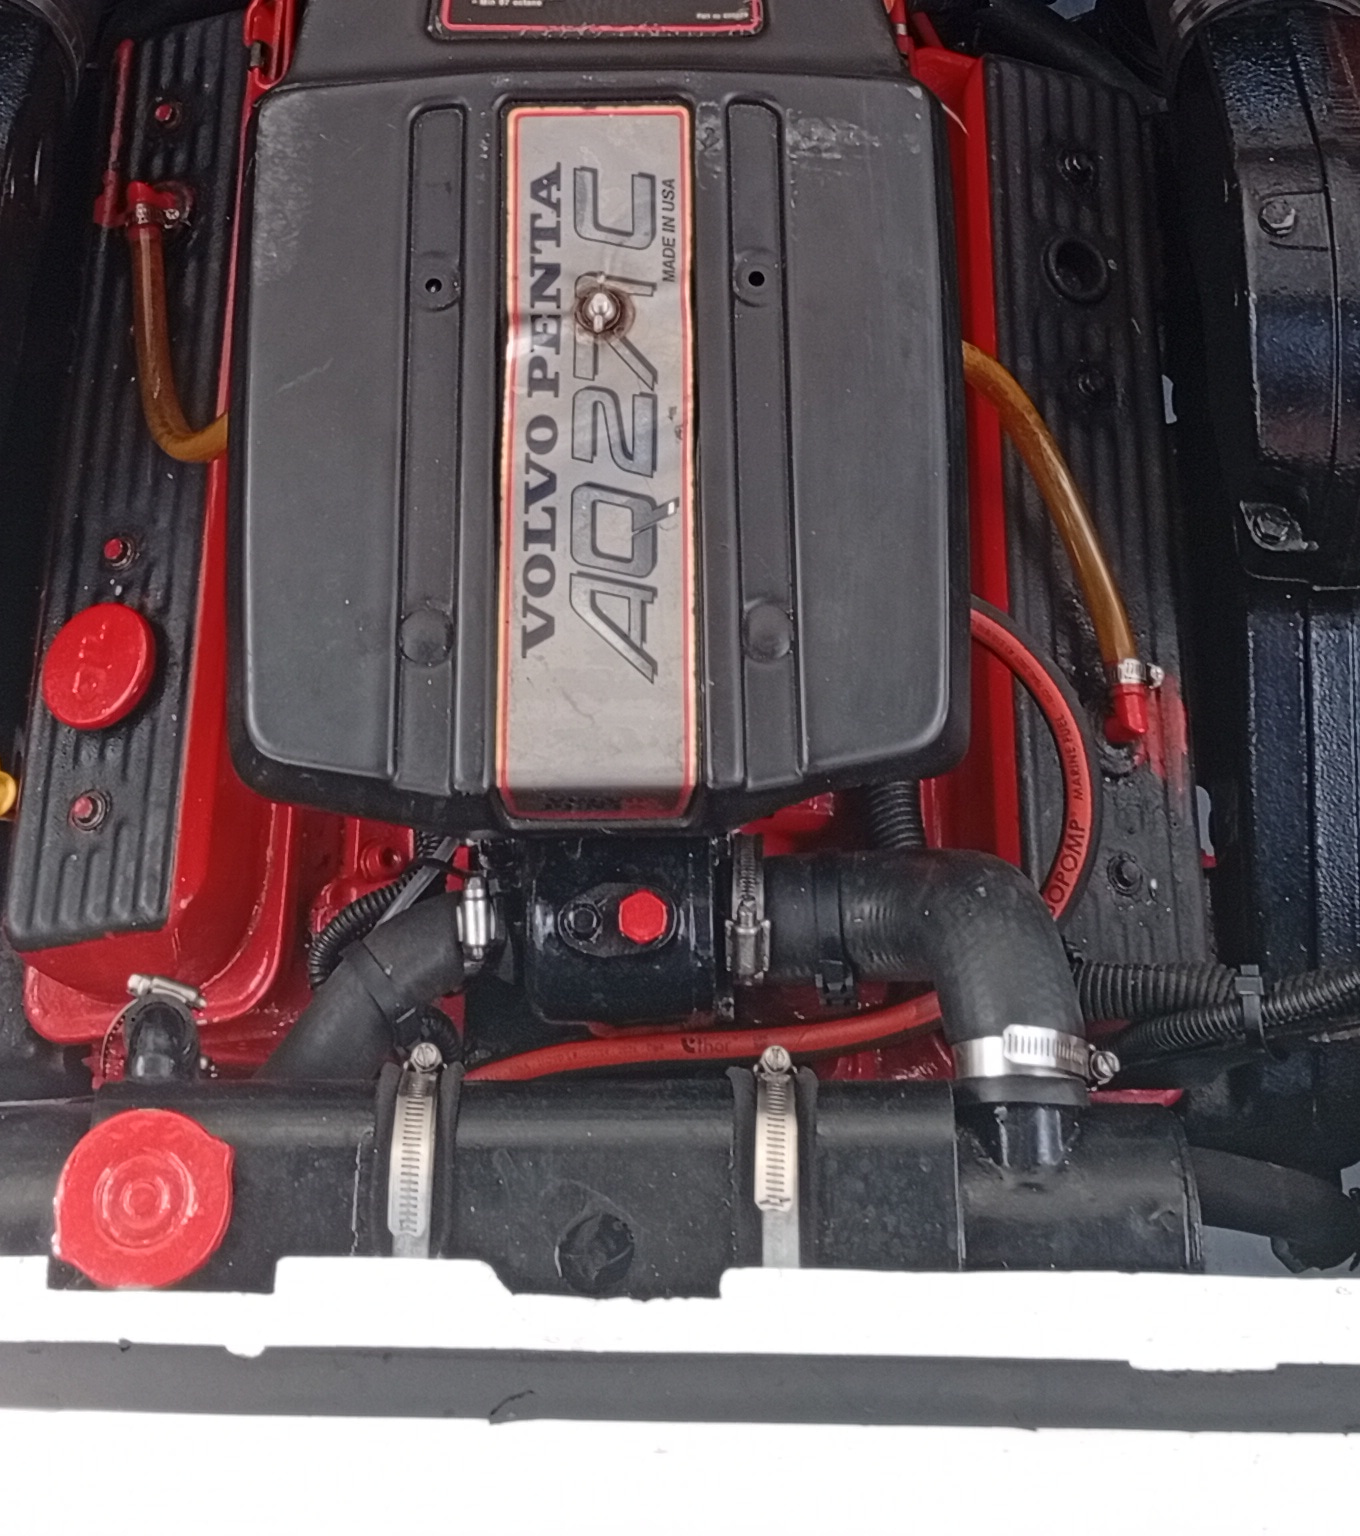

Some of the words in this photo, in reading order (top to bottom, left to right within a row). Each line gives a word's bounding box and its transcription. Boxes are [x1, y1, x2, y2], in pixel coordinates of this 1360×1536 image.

[661, 178, 676, 212] USA
[661, 215, 676, 233] IN
[526, 162, 562, 399] PENTA
[661, 236, 676, 283] MADE
[521, 414, 560, 659] VOLVO
[1054, 713, 1072, 743] FUEL
[1066, 746, 1083, 801] MARINE
